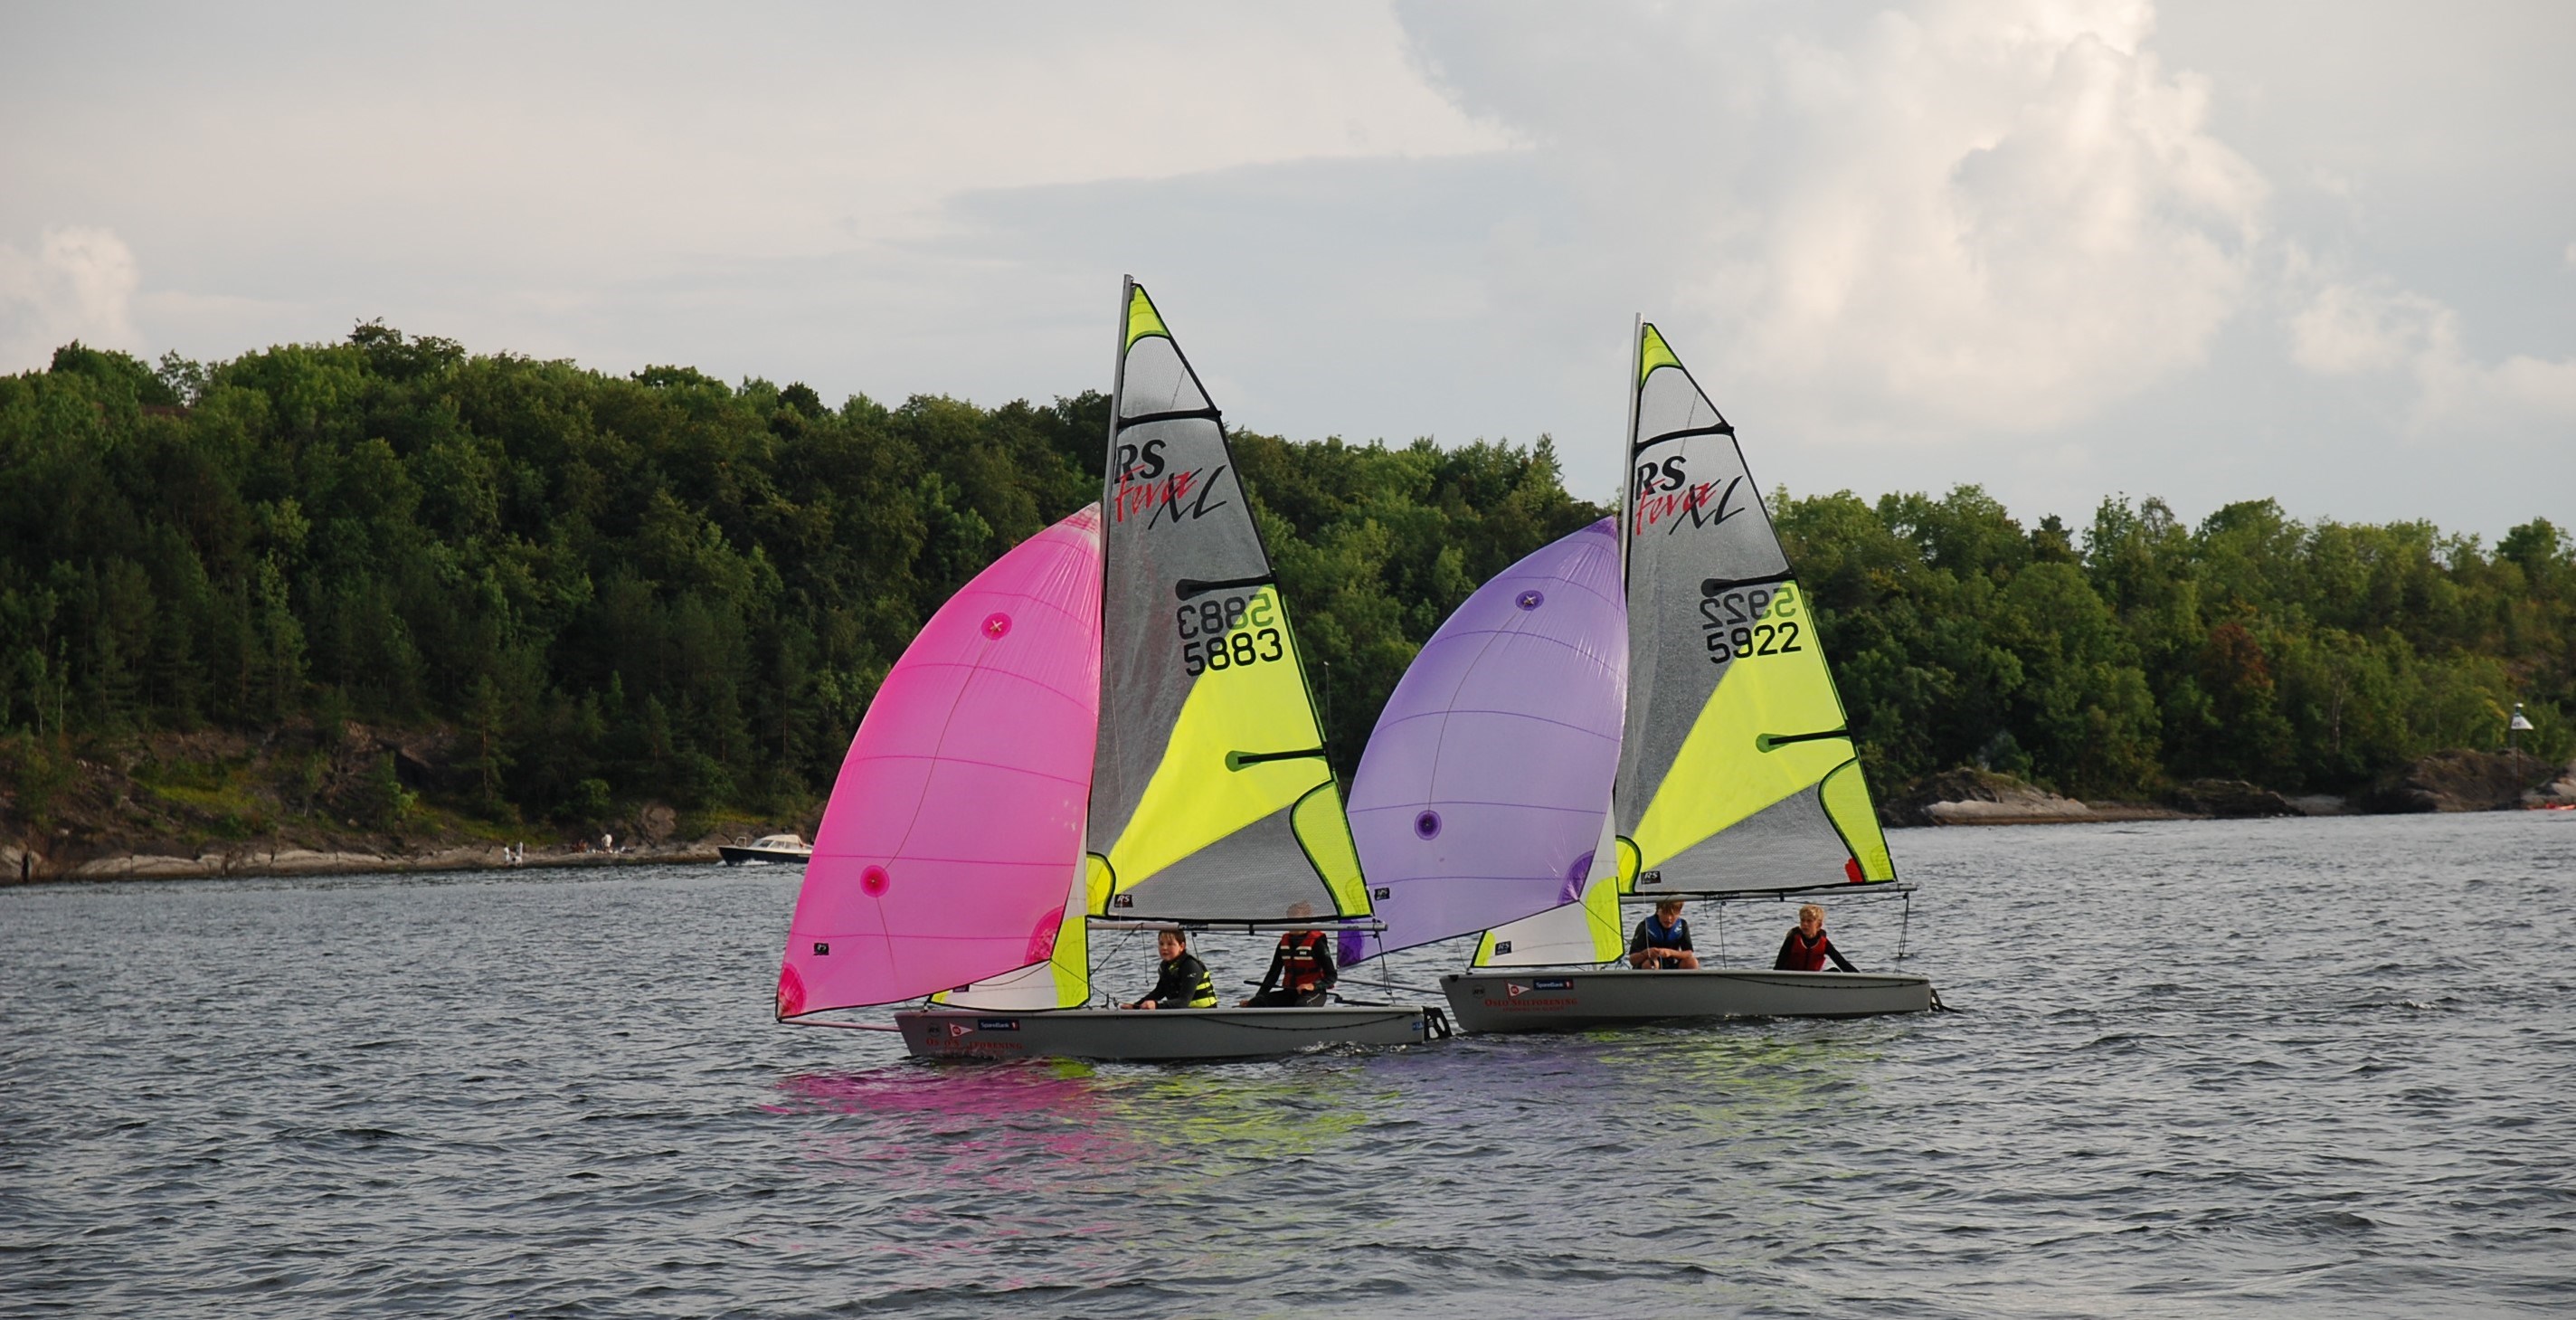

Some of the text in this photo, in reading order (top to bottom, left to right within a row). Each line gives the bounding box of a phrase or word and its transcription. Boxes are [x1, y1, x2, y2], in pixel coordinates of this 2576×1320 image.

[1113, 439, 1167, 484] RS
[1635, 455, 1687, 500] RS
[1148, 464, 1227, 530] XL
[1668, 475, 1746, 536] XL
[1183, 628, 1283, 678] 5883
[1706, 622, 1803, 664] 5922
